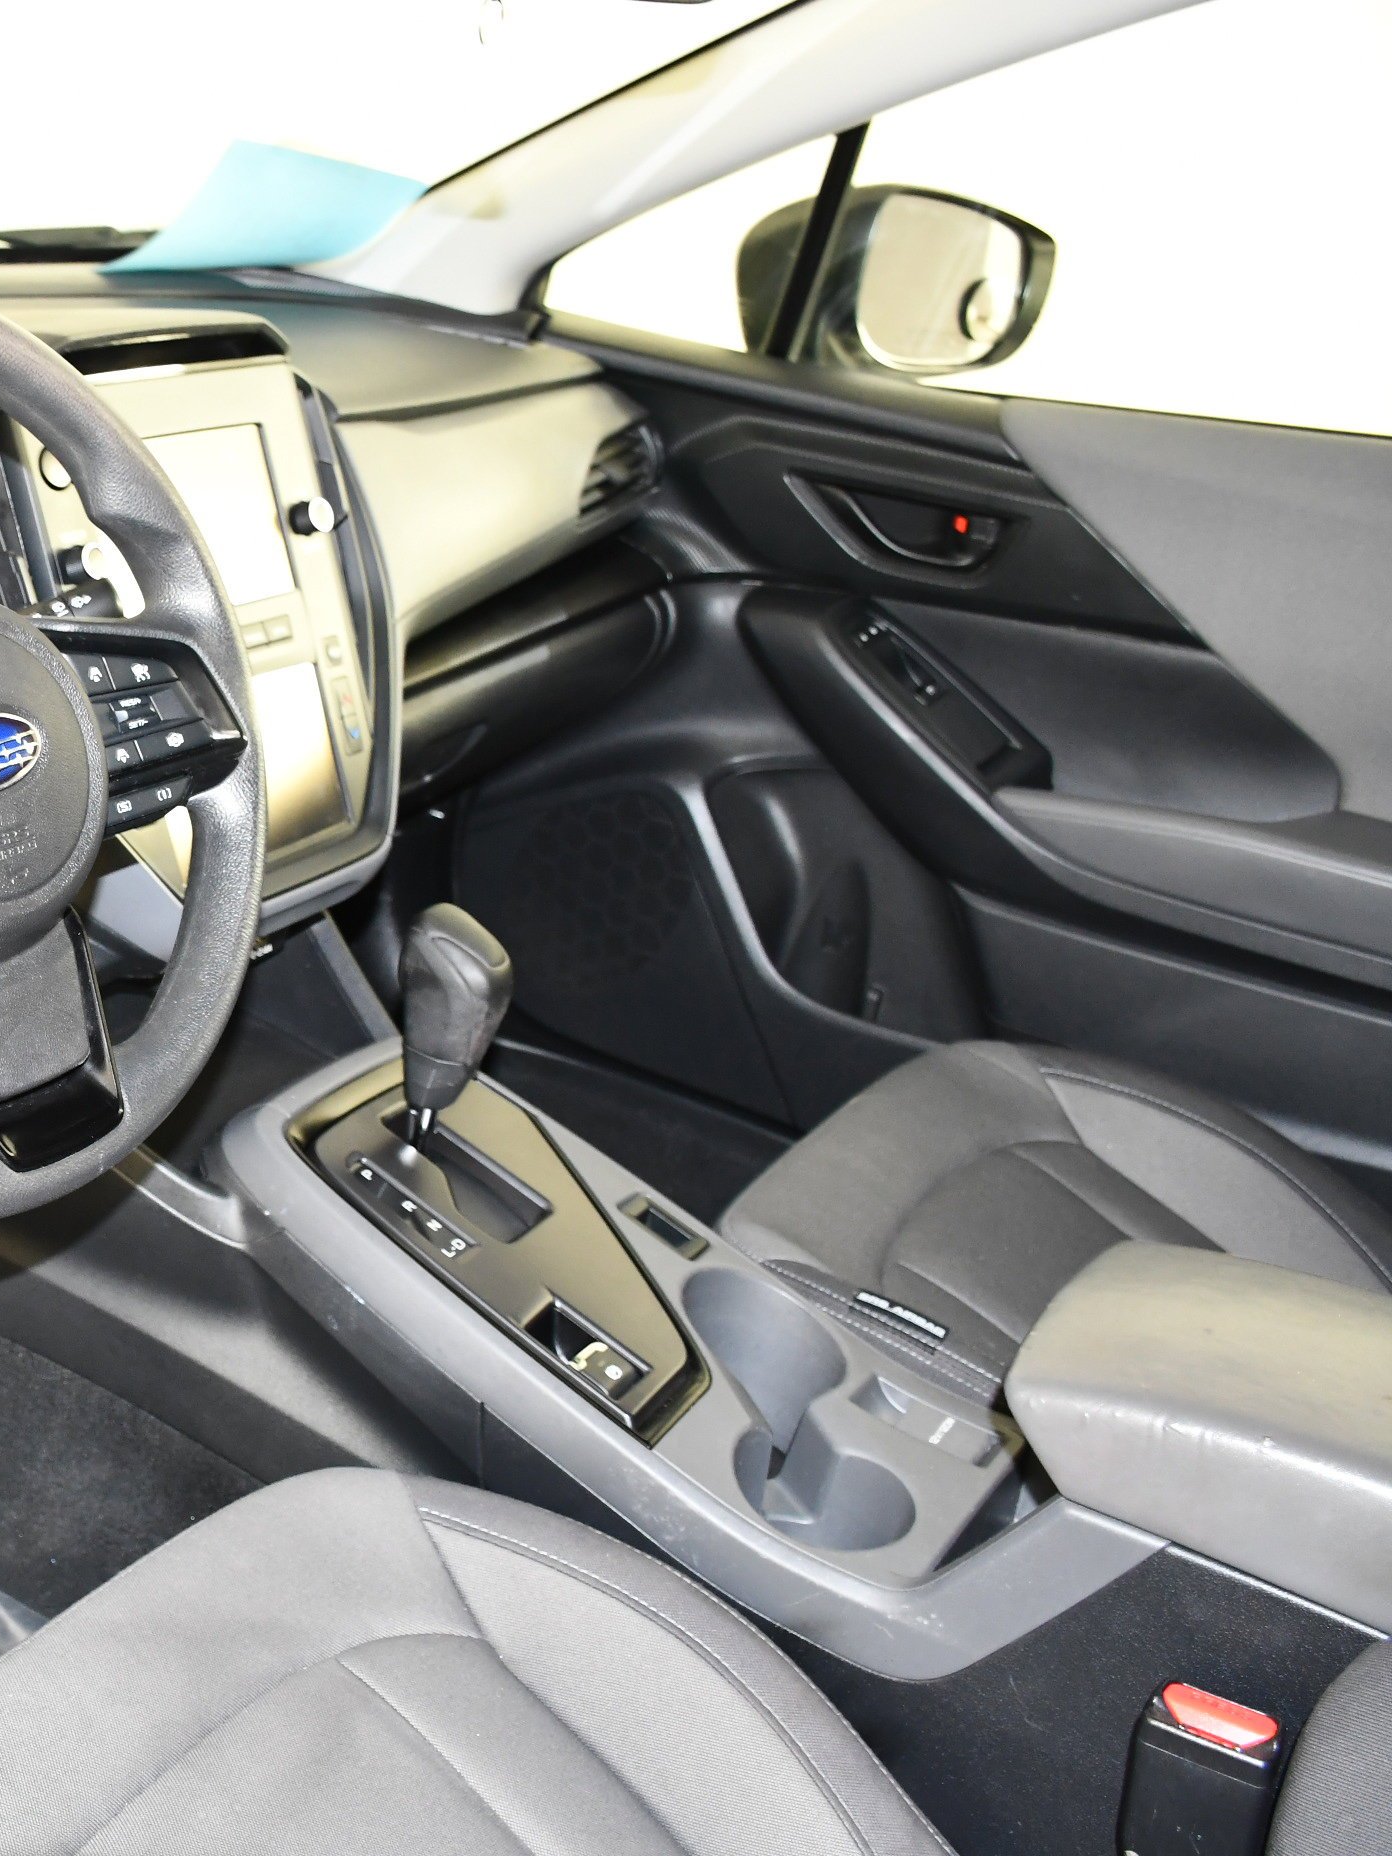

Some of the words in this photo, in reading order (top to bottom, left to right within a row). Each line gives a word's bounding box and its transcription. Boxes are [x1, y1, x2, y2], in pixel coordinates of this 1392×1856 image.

[360, 1169, 373, 1181] P
[401, 1200, 418, 1213] R
[426, 1218, 443, 1232] N
